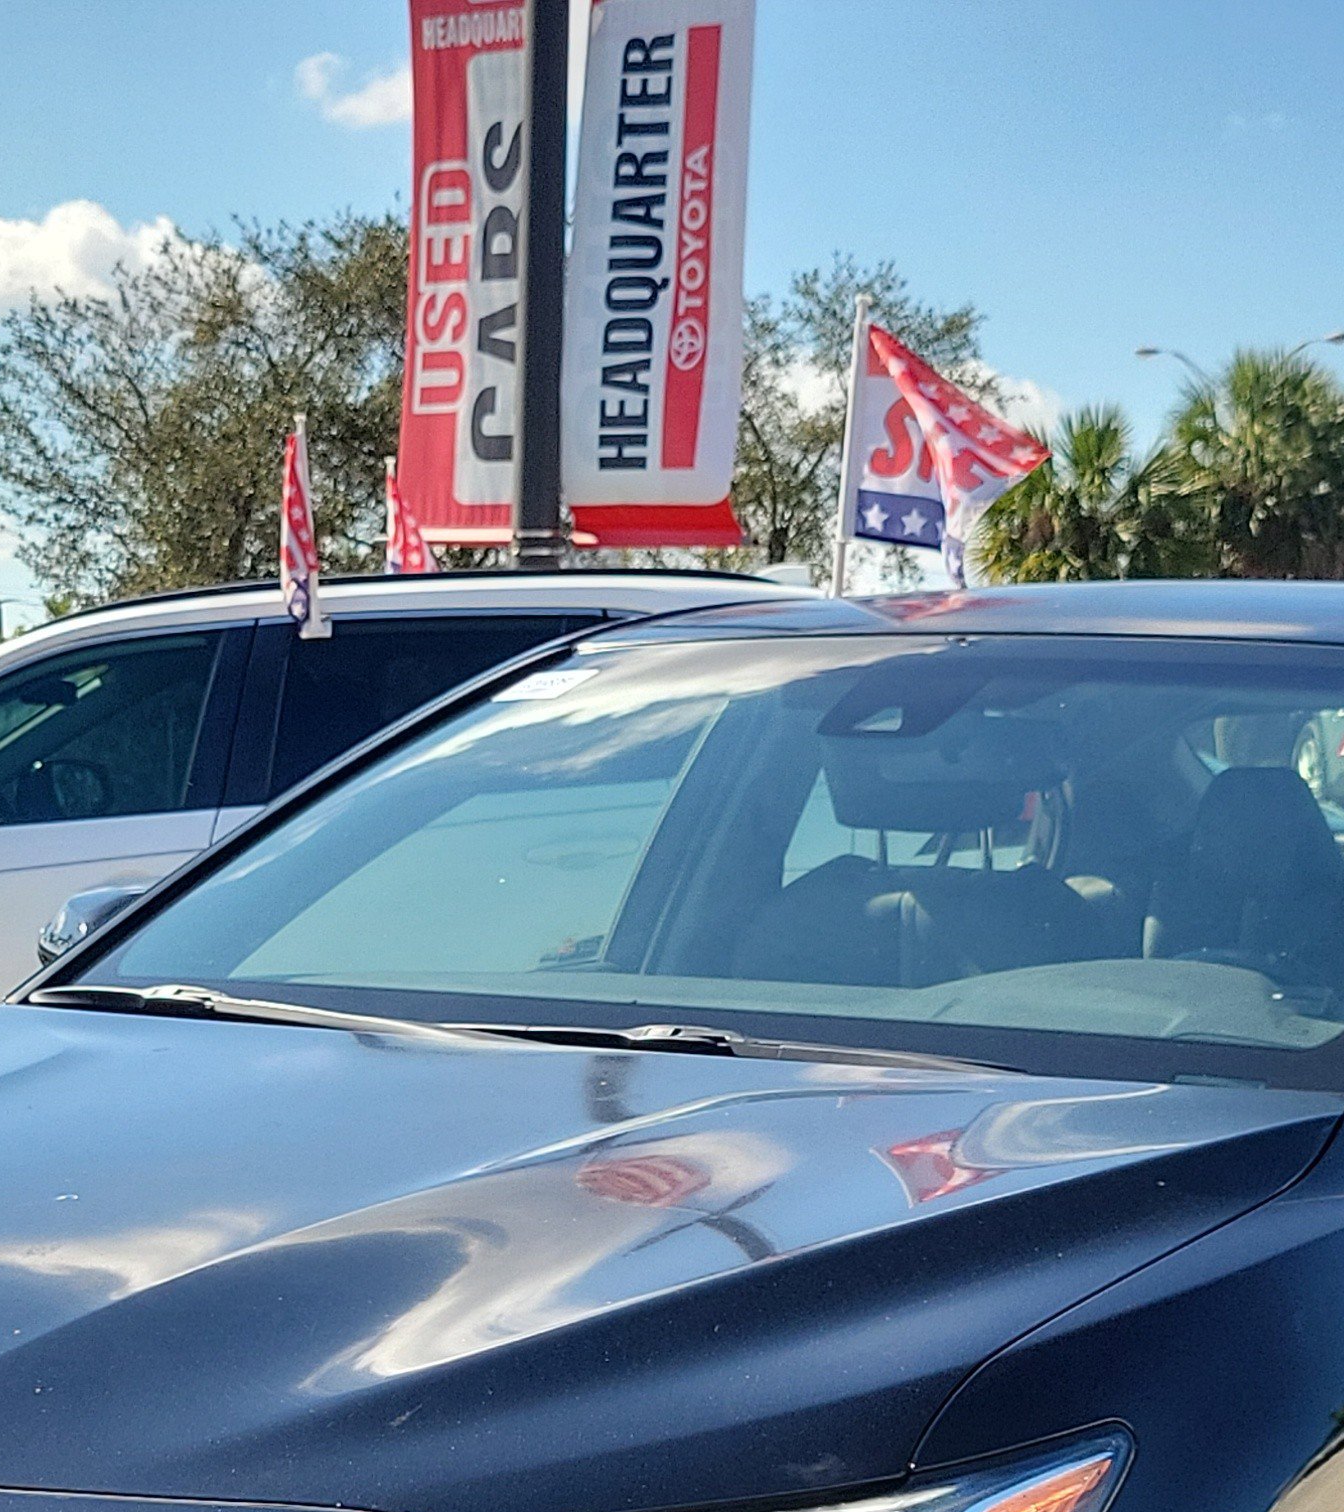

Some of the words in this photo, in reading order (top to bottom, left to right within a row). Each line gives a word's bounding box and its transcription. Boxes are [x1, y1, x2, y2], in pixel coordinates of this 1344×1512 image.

[413, 160, 475, 415] USED
[598, 32, 676, 471] HEADQUARTER
[677, 144, 711, 317] TOYOTA
